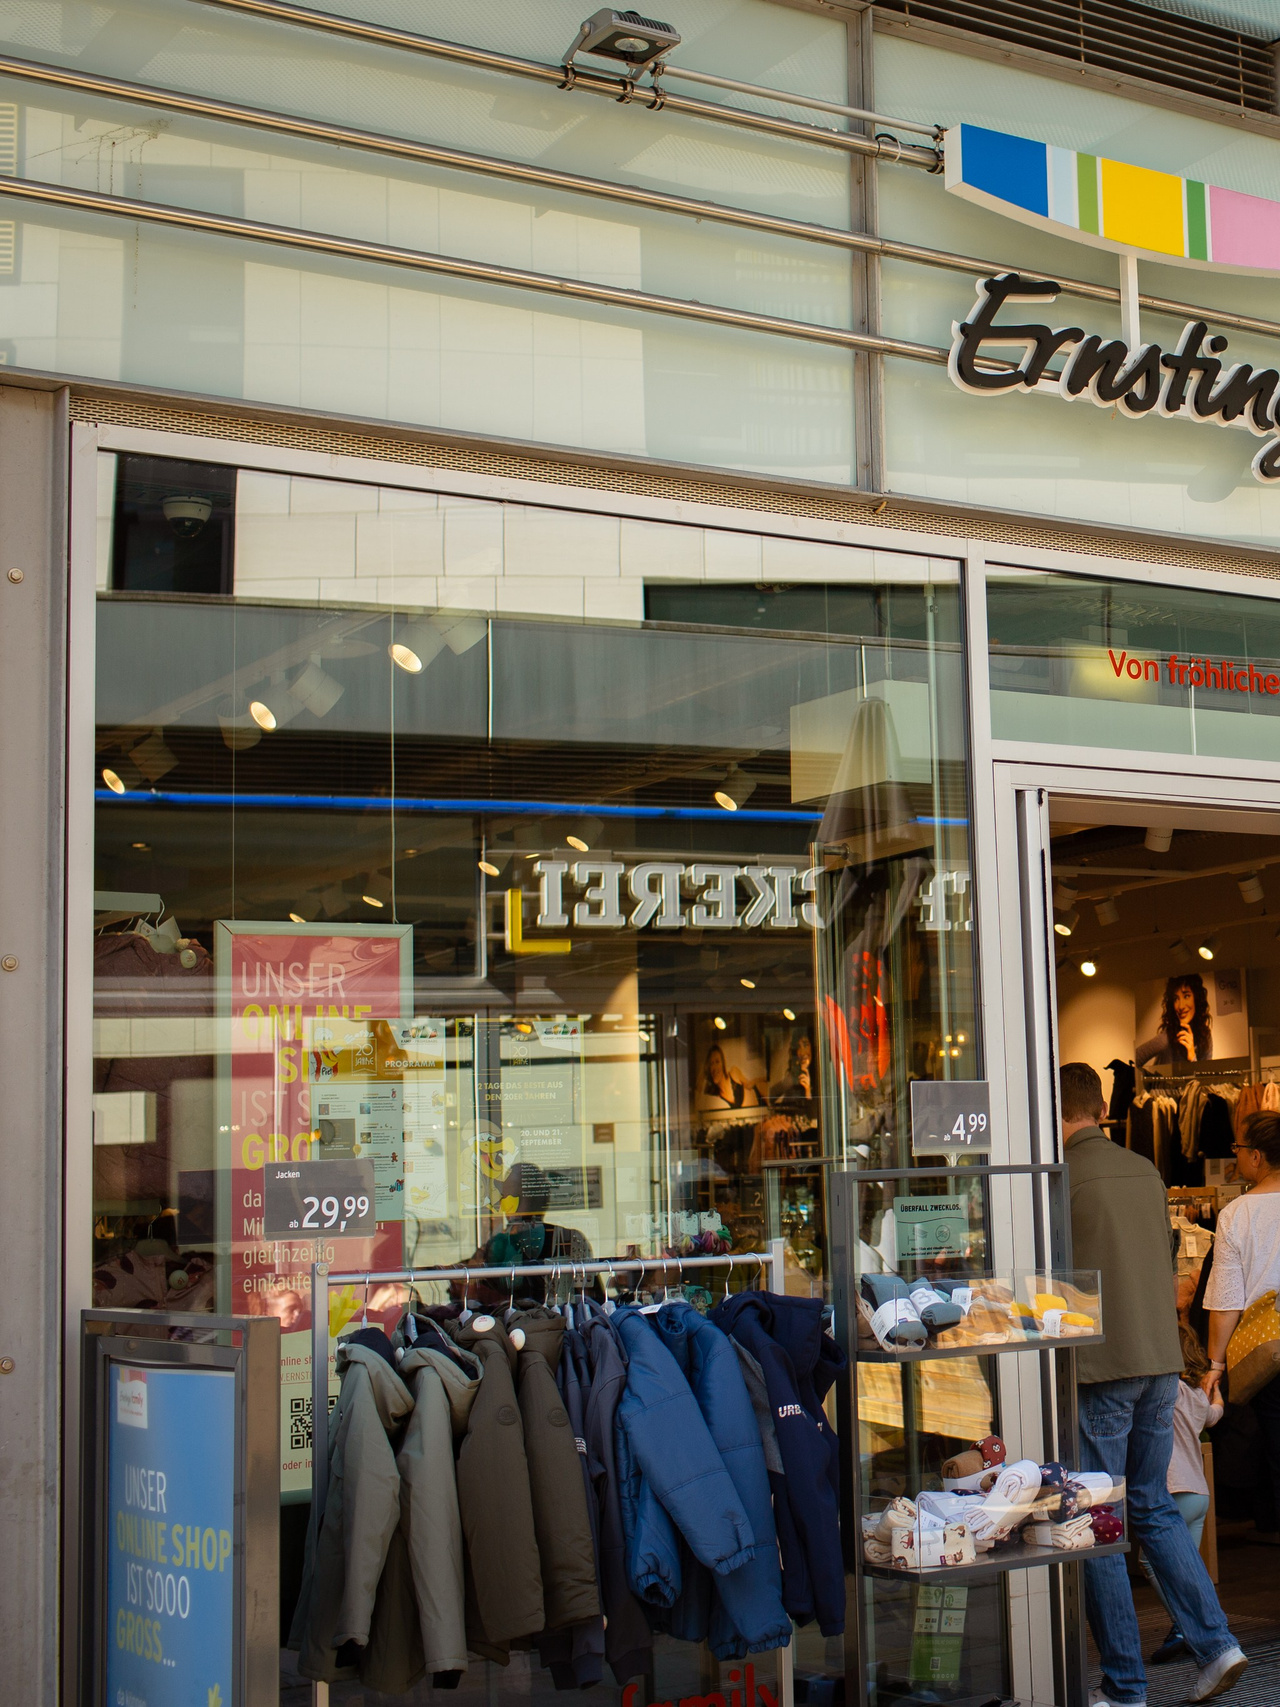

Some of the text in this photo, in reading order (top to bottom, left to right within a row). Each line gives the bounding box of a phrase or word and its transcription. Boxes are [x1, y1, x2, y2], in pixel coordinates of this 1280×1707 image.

[1108, 649, 1159, 682] Von
[242, 961, 345, 998] UNSER
[355, 1043, 374, 1056] 20
[513, 1046, 528, 1057] 20
[385, 1060, 436, 1068] PROGRAMM
[484, 1082, 504, 1090] TAGE
[547, 1081, 564, 1089] AUS
[485, 1093, 501, 1101] DEN
[504, 1092, 523, 1101] 20ER
[241, 1090, 288, 1127] IST
[951, 1113, 987, 1145] 4,99
[520, 1138, 562, 1146] SEPTEMBER
[275, 1171, 301, 1179] Jacken
[288, 1219, 299, 1229] ab
[301, 1196, 370, 1233] 29,99
[900, 1203, 929, 1213] ÜBERFALL
[243, 1272, 313, 1294] einkaufe
[282, 1460, 302, 1471] oder
[124, 1463, 168, 1514] UNSER
[116, 1511, 232, 1573] ONLINE SHOP
[126, 1561, 191, 1619] IST SOOO
